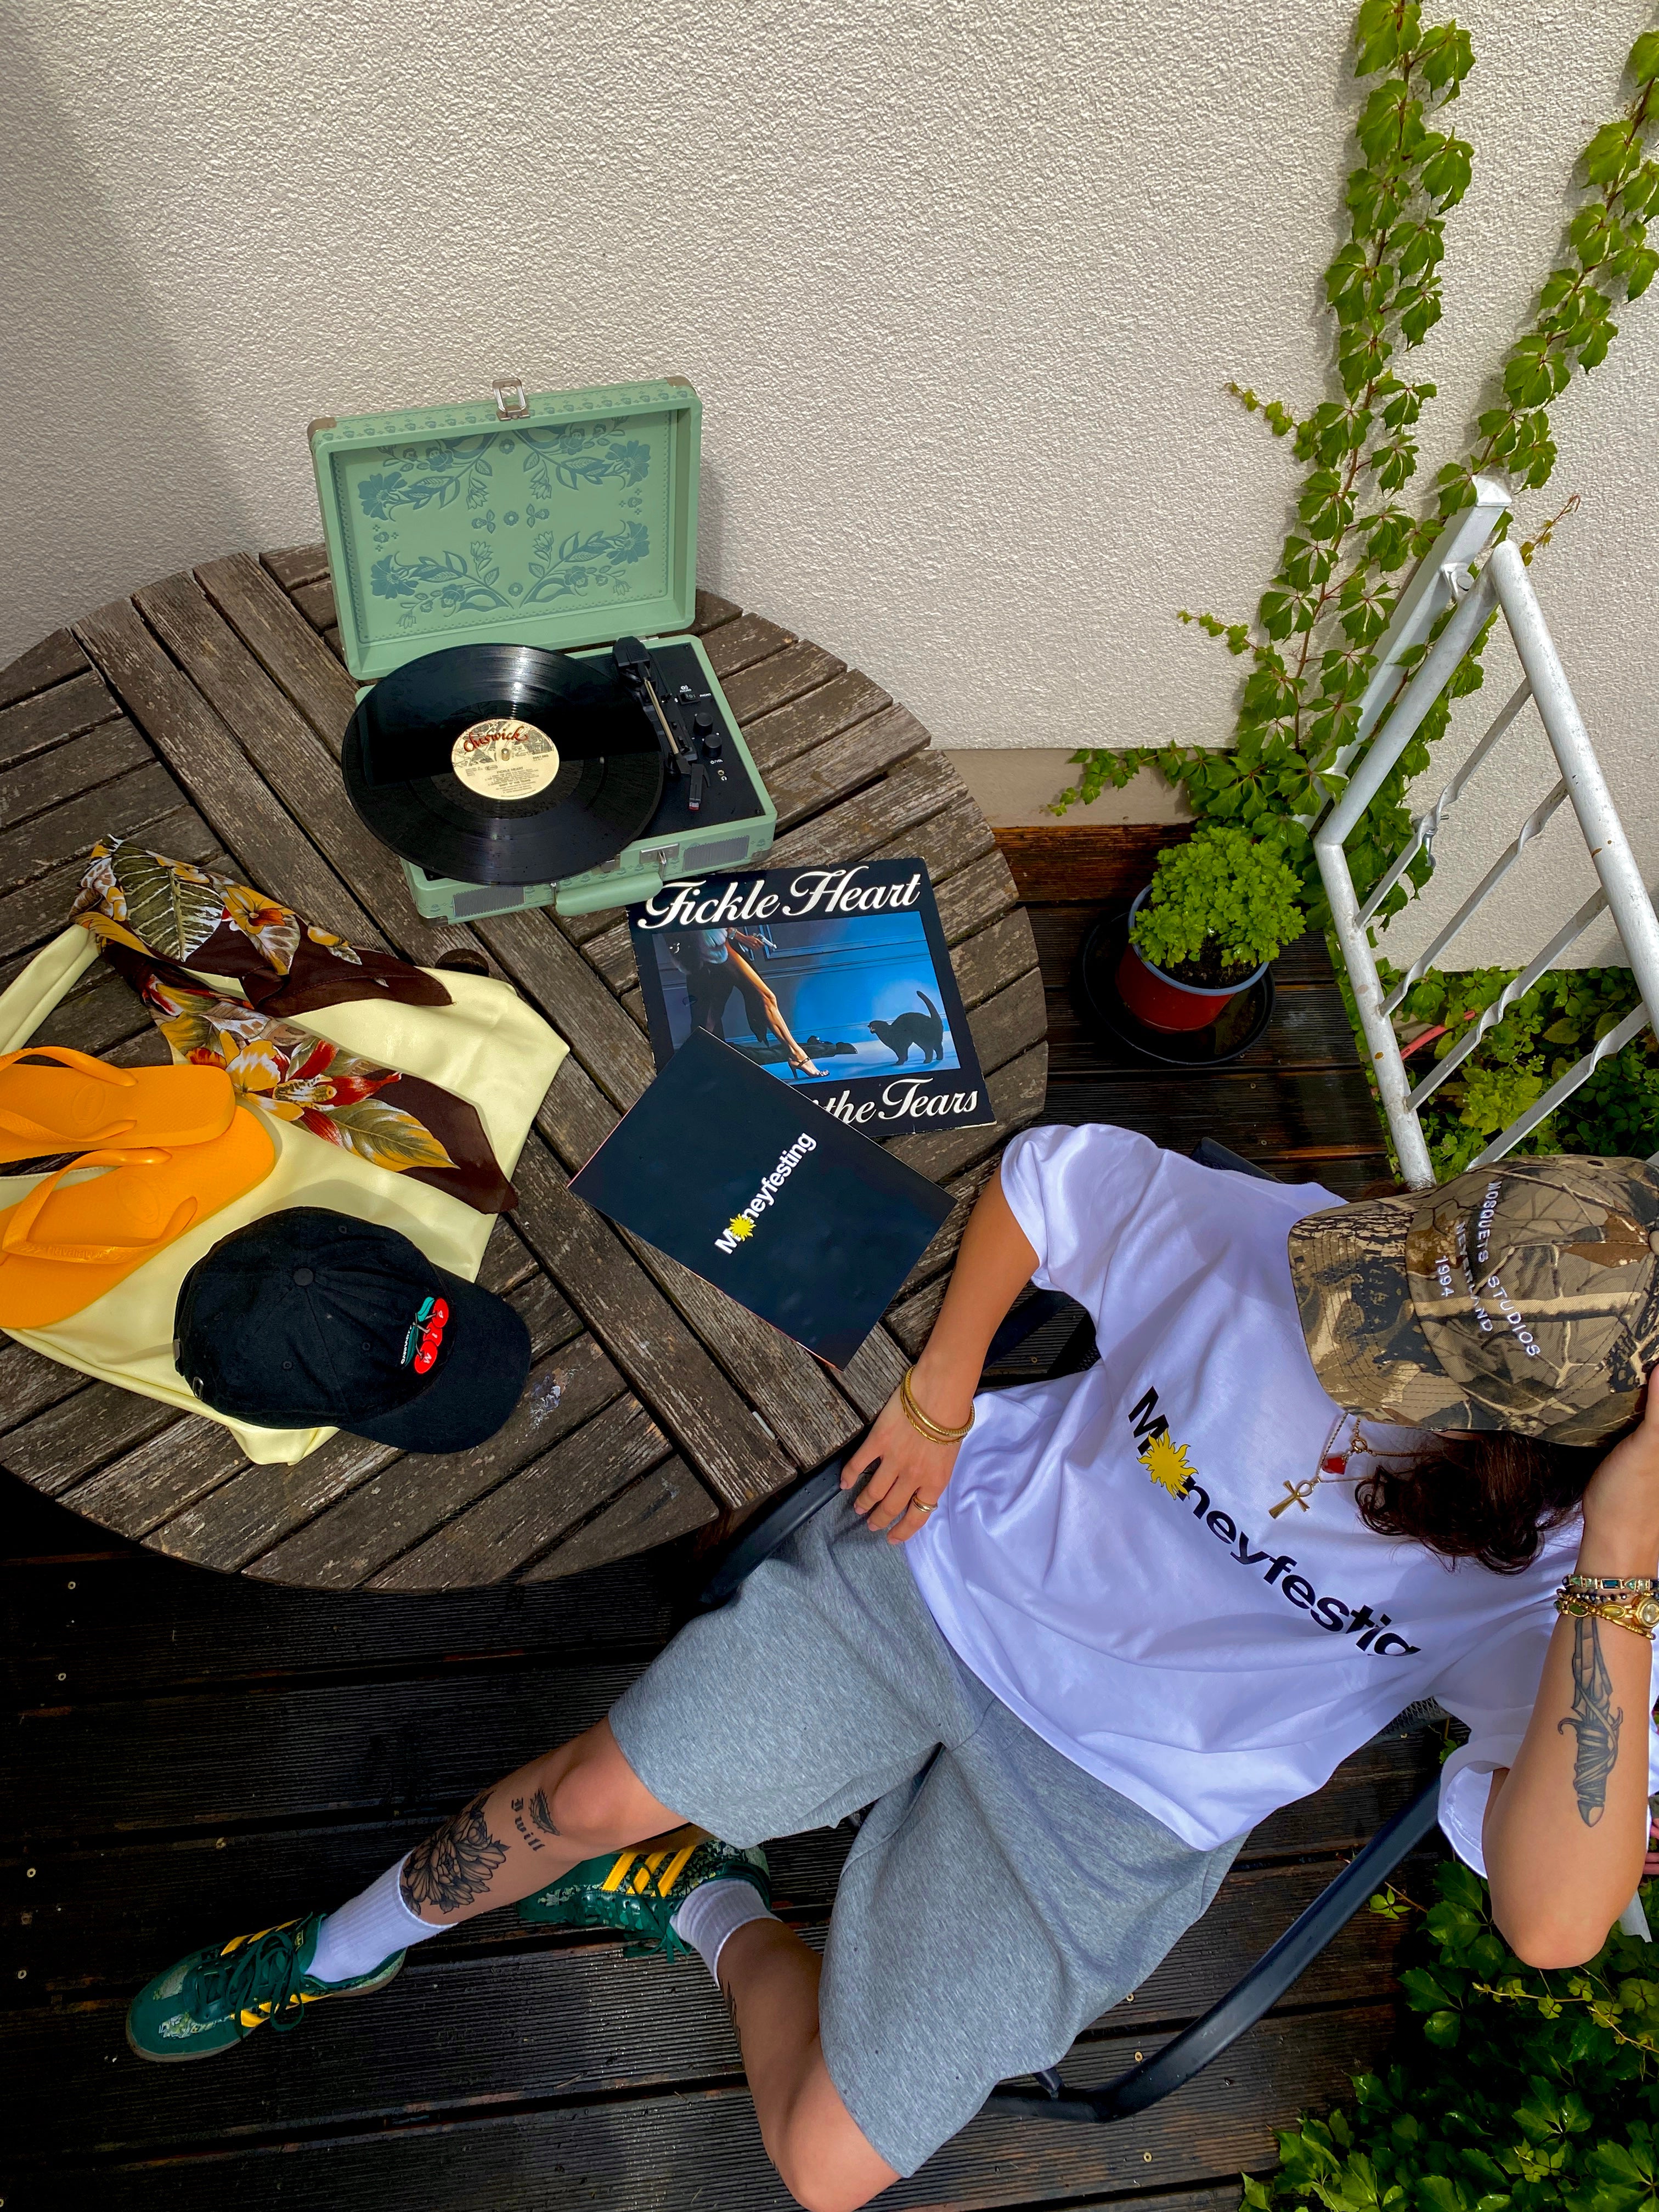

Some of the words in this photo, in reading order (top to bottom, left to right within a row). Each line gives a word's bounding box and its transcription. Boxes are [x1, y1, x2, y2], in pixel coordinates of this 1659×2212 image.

[638, 879, 780, 929] Fickle
[783, 866, 921, 916] Heart
[823, 1090, 877, 1124] the
[878, 1078, 978, 1120] Tears
[714, 1132, 817, 1254] Mneyfesting
[1435, 1255, 1454, 1297] 1994
[1456, 1221, 1493, 1331] NEVERLAND
[1488, 1276, 1541, 1356] STUDIOS
[1128, 1385, 1421, 1656] Mneyfestig
[515, 1815, 545, 1852] will
